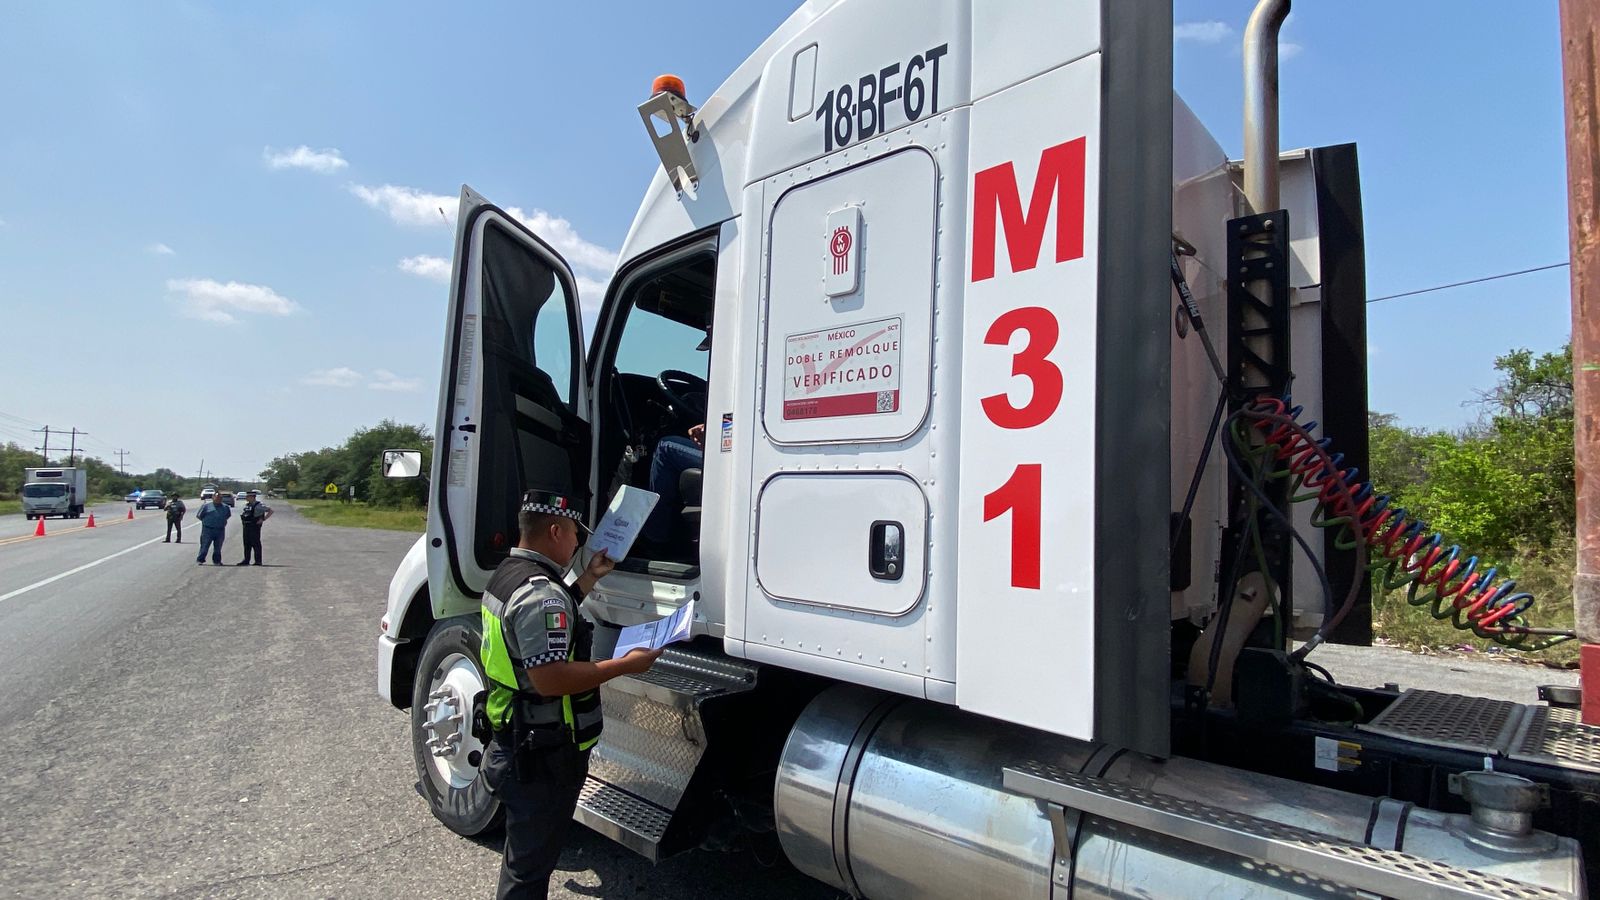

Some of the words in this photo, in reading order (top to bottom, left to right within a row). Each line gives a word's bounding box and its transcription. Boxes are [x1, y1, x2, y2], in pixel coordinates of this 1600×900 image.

[827, 329, 856, 341] MÉXICO
[887, 324, 898, 332] SCT
[788, 352, 823, 366] DOBLE
[829, 340, 898, 360] REMOLQUE
[793, 364, 893, 388] VERIFICADO
